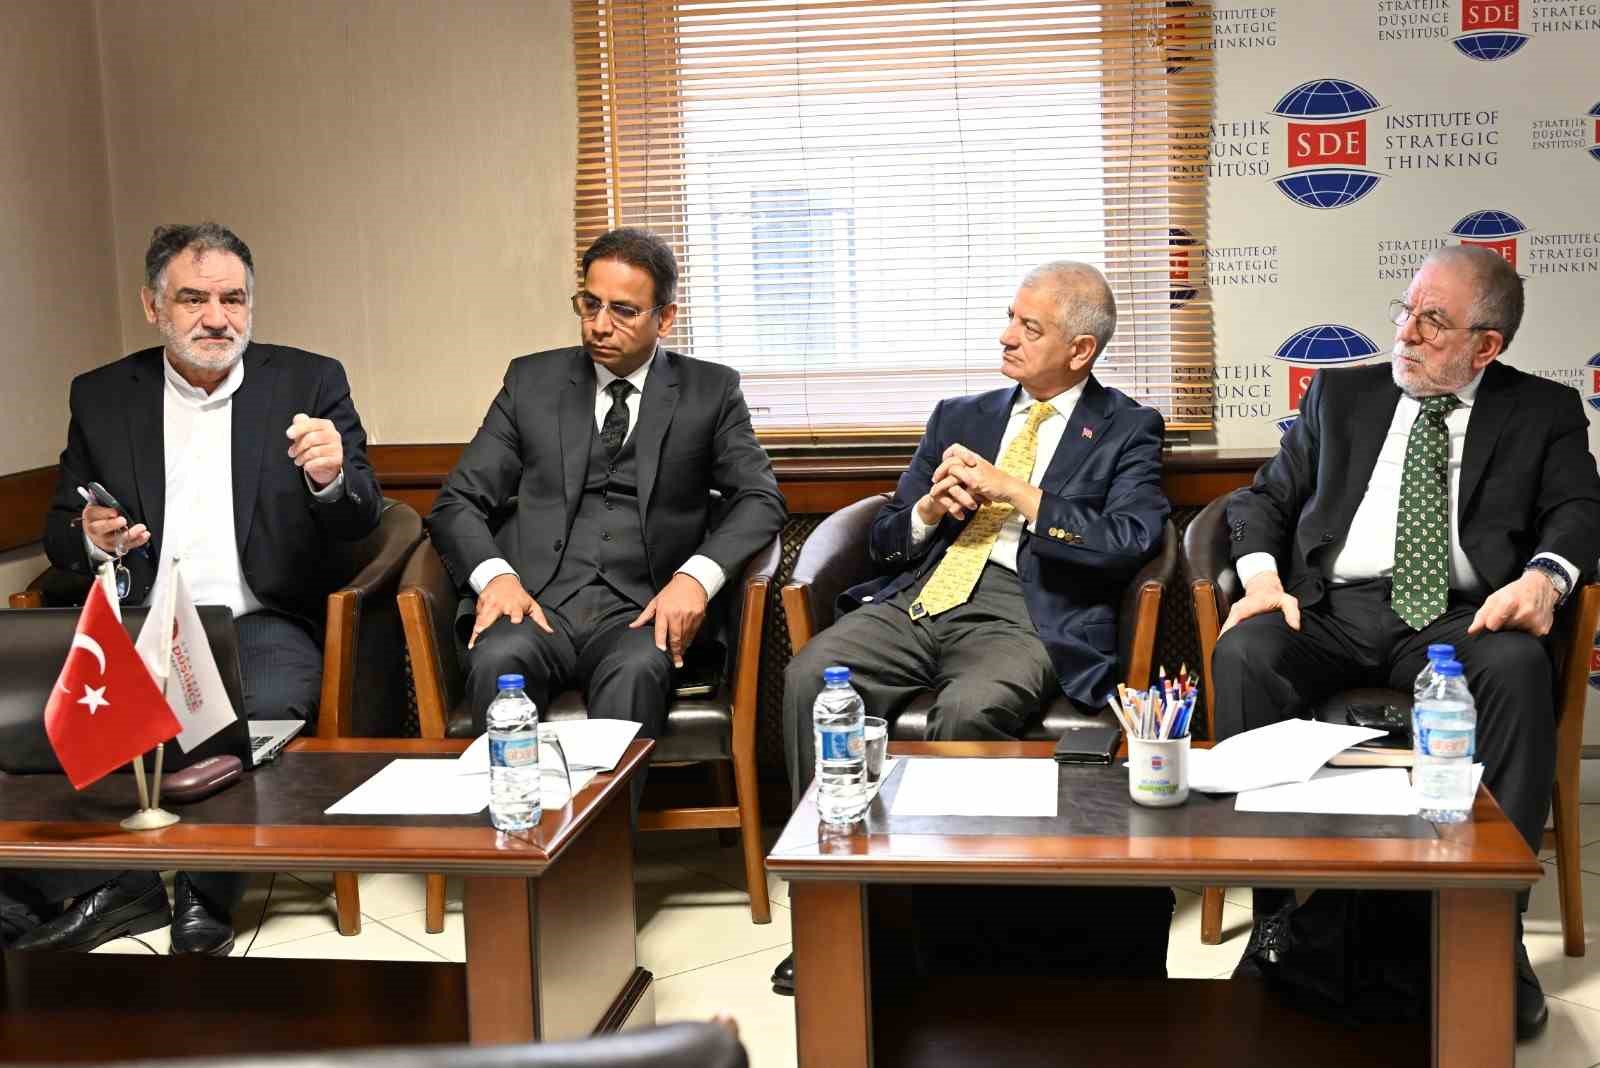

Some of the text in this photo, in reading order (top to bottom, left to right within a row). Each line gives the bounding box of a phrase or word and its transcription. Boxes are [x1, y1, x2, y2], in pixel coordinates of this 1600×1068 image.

[1198, 8, 1277, 20] STITUTE OF
[1468, 5, 1514, 24] SDE
[1532, 6, 1597, 18] STRATEG
[1215, 22, 1276, 34] RATEGIC
[1532, 20, 1600, 33] THINKIN
[1386, 111, 1499, 129] INSTITUTE OF
[1296, 131, 1361, 157] SDE
[1385, 131, 1499, 150] STRATEGIC
[1384, 152, 1498, 170] THINKING
[1530, 234, 1589, 246] INSTITUTE
[1261, 246, 1278, 256] OF
[1530, 248, 1600, 260] STRATEGI
[1530, 262, 1600, 274] THINKIN
